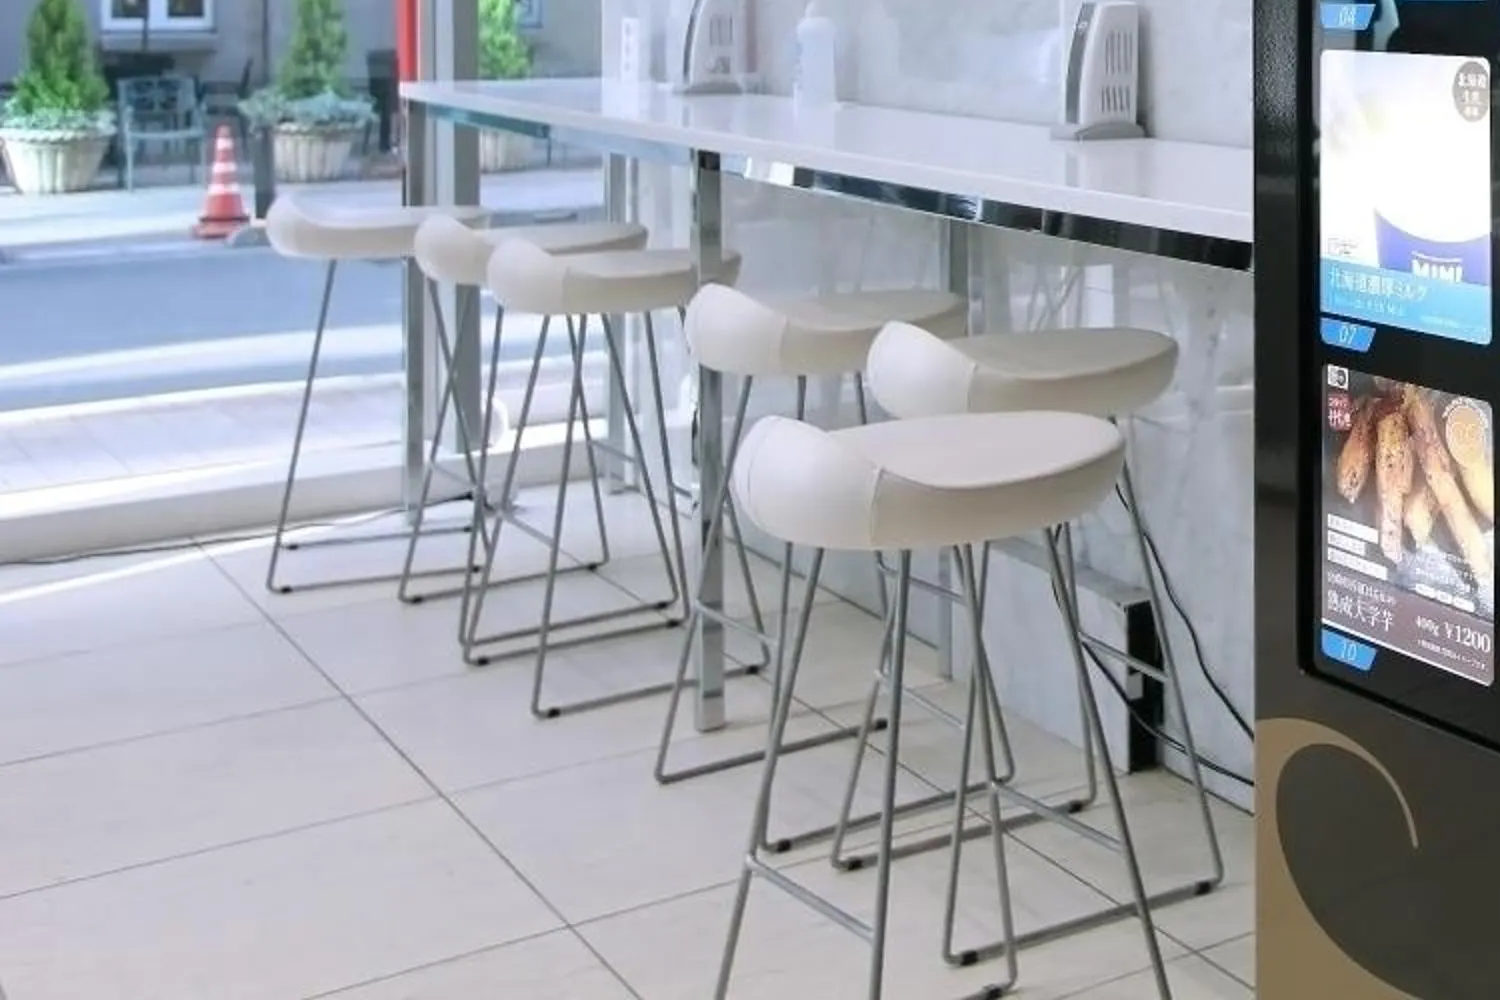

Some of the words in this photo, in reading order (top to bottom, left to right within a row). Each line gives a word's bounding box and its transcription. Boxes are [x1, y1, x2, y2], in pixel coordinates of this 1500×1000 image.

[1338, 324, 1358, 345] 07
[1443, 621, 1491, 654] ¥1200
[1339, 640, 1358, 663] 10
